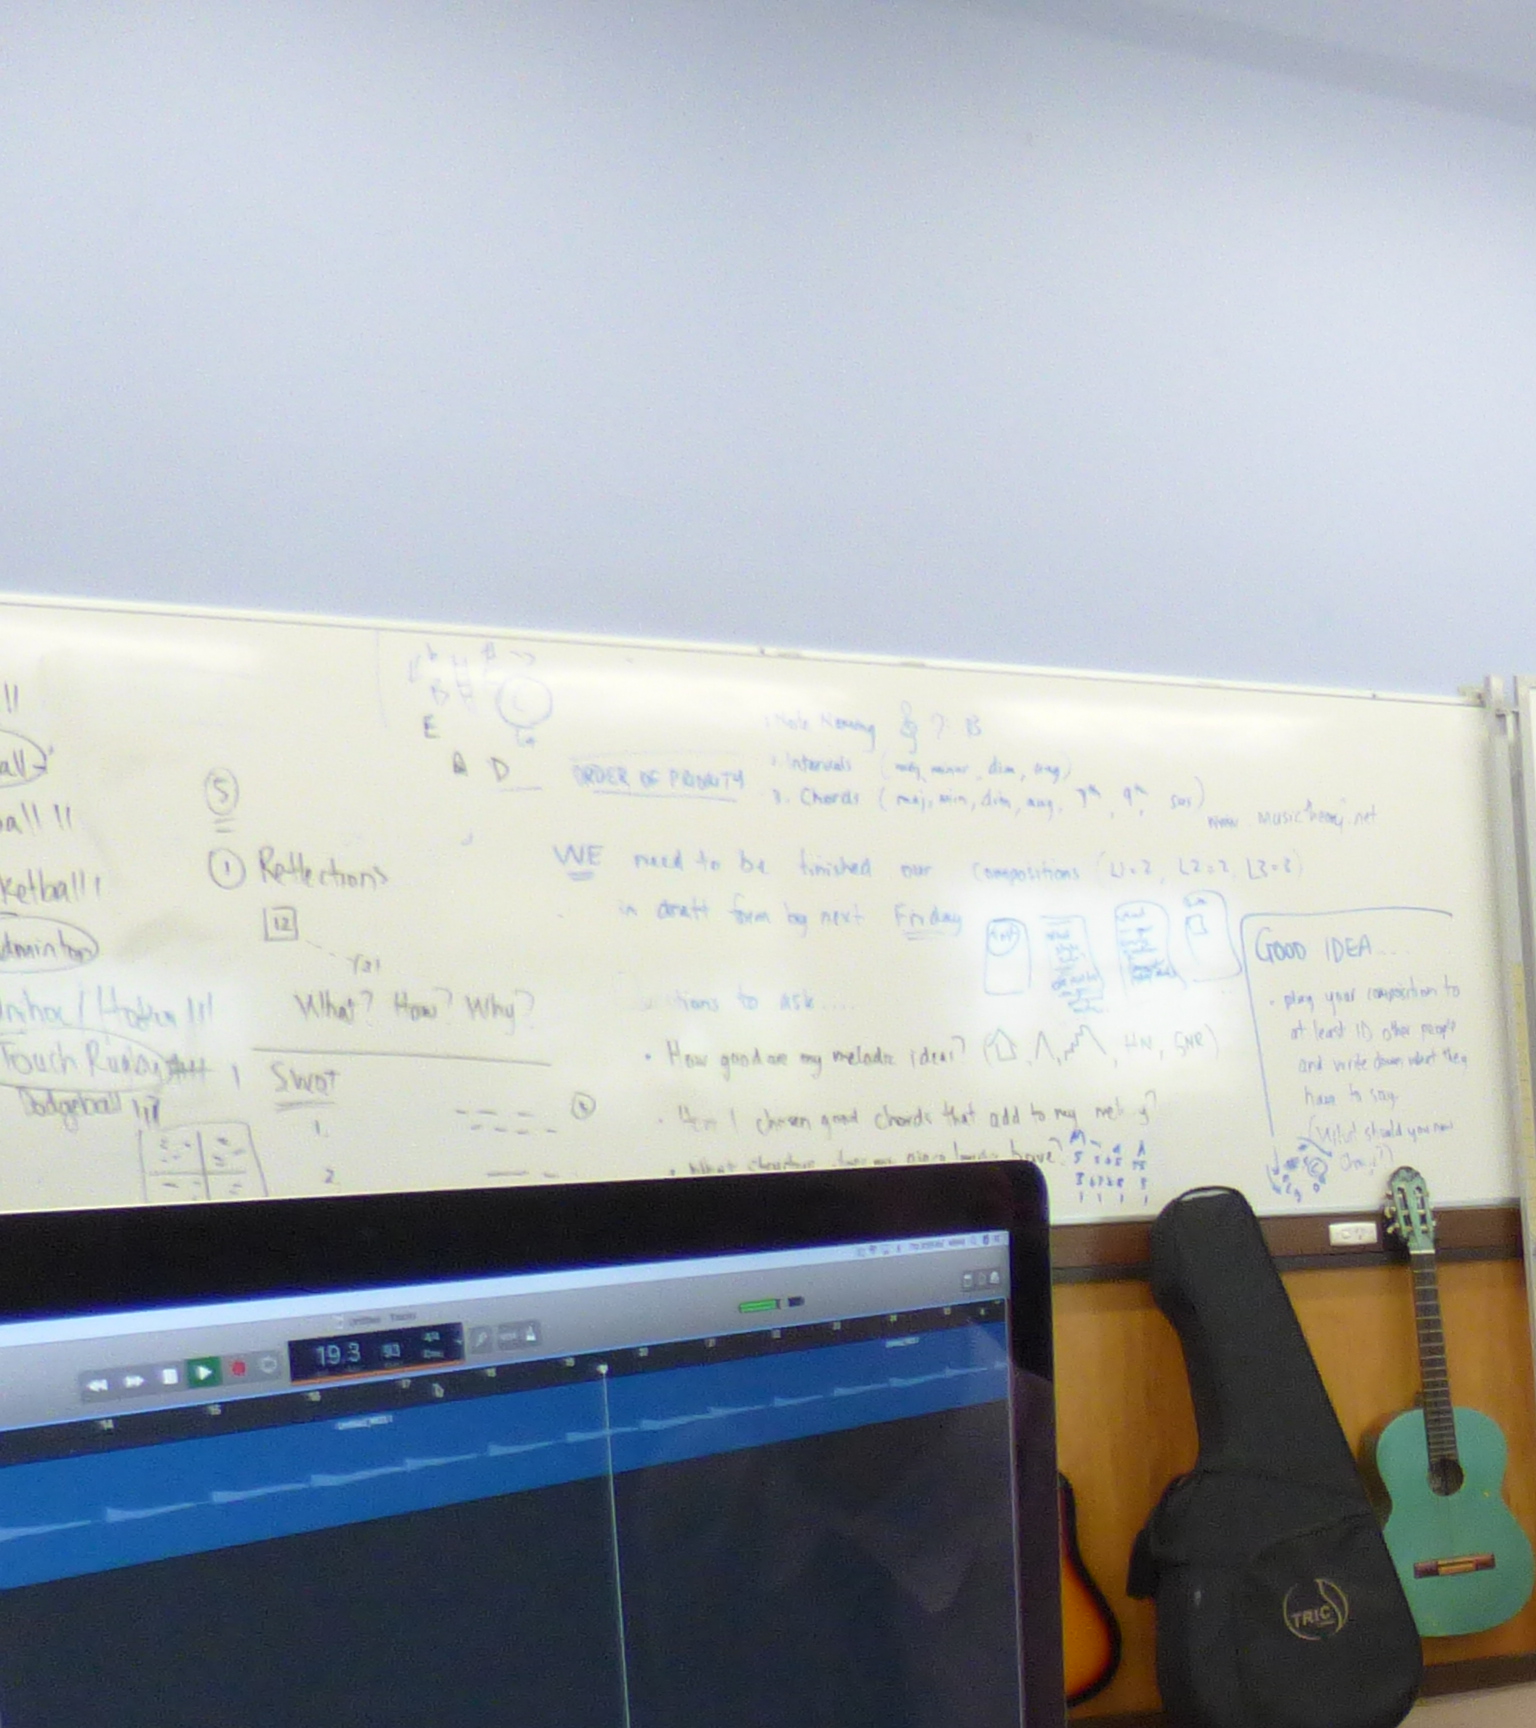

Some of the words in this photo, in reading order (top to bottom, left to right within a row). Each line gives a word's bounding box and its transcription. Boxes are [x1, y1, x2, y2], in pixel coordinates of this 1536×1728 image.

[552, 843, 603, 866] WE
[632, 849, 684, 870] need
[695, 849, 721, 872] to
[738, 848, 769, 875] be
